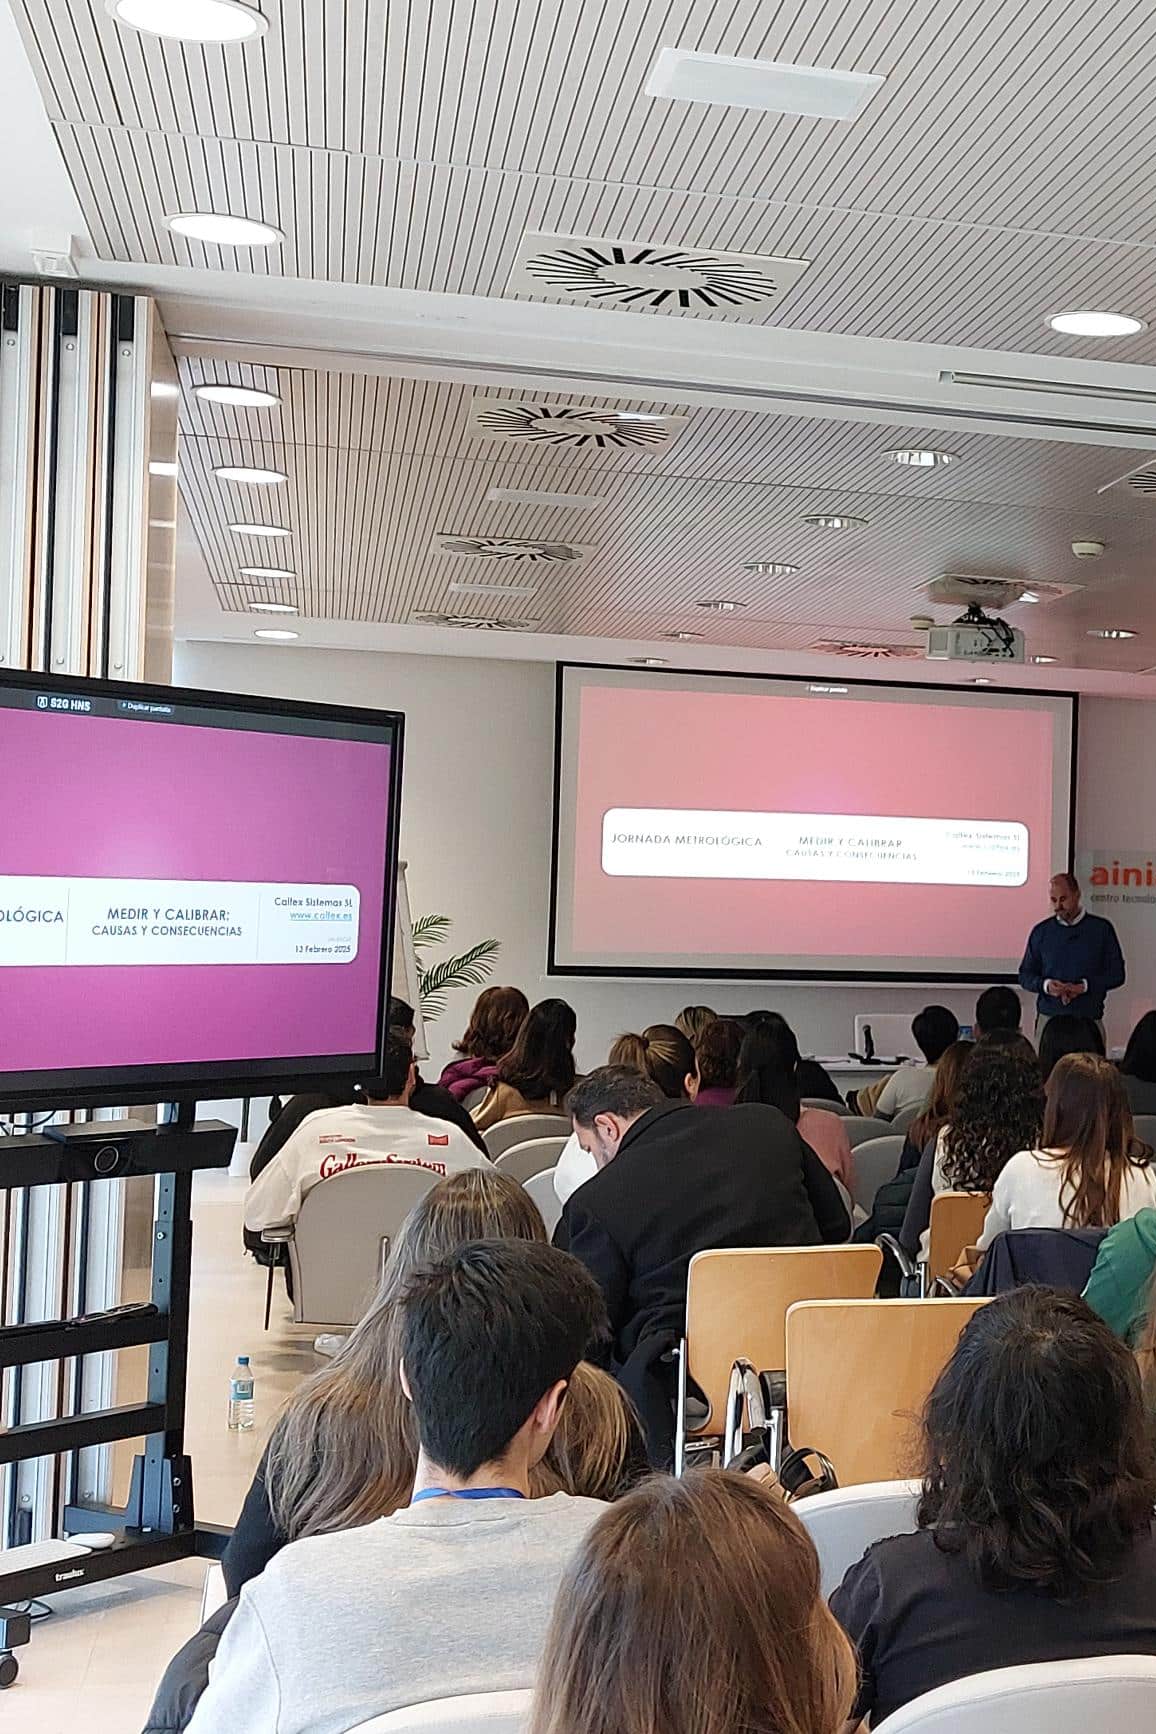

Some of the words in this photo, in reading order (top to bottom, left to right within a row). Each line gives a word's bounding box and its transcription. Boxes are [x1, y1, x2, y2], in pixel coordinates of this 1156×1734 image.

[612, 833, 671, 844] JORNADA
[675, 834, 762, 846] METROLÓGICA
[107, 908, 148, 921] MEDIR
[153, 908, 161, 920] Y
[165, 908, 230, 922] CALIBRAR:
[92, 925, 137, 936] CAUSAS
[141, 926, 147, 936] Y
[151, 926, 243, 937] CONSECUENCIAS
